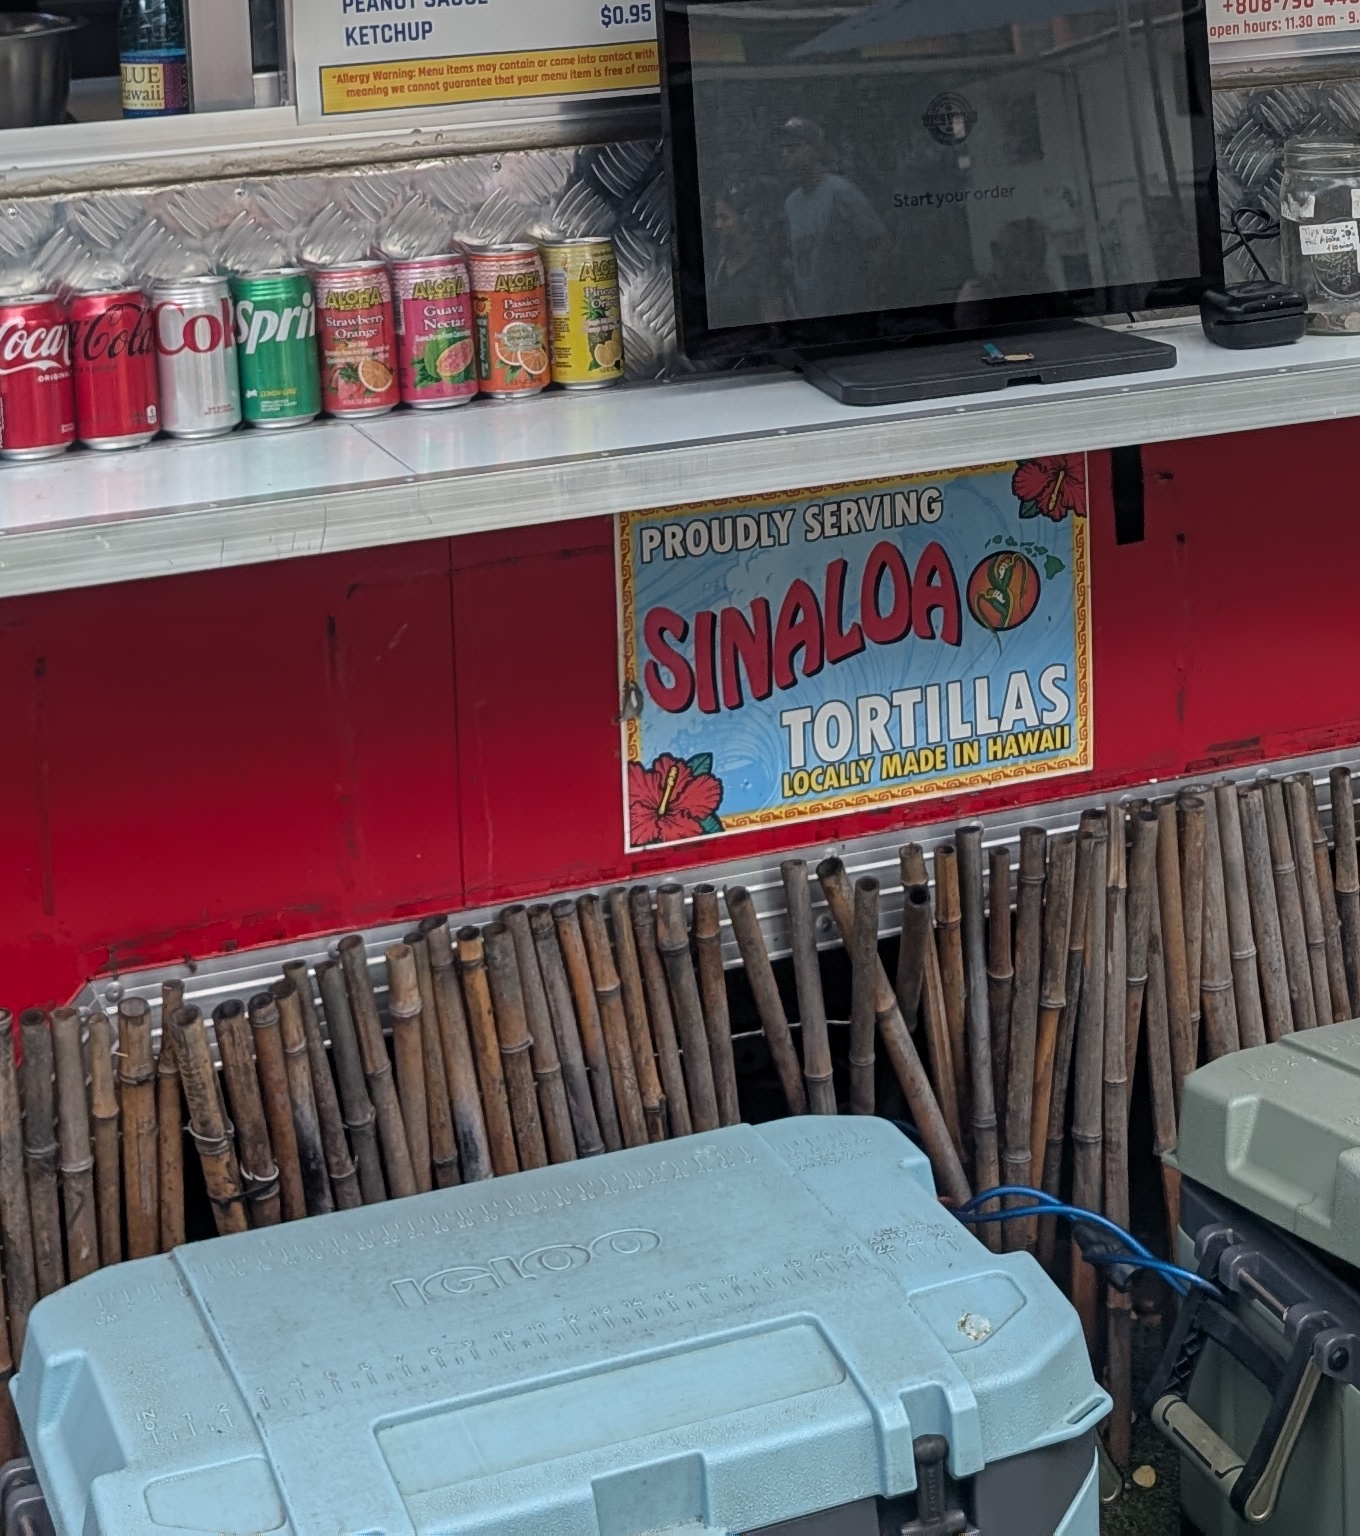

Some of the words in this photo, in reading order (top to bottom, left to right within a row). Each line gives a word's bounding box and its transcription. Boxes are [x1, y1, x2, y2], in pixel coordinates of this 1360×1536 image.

[1210, 24, 1239, 38] open
[1244, 19, 1282, 32] hours:
[1285, 15, 1313, 29] 11.30
[1318, 15, 1335, 26] am
[894, 192, 932, 207] Start
[936, 191, 970, 208] your
[974, 185, 1015, 200] order
[326, 286, 382, 310] ALOHA
[412, 275, 465, 299] ALOHA
[423, 305, 464, 316] Guava
[335, 328, 377, 339] Orange
[423, 319, 464, 329] Nectar
[640, 510, 793, 563] PROUDLY
[804, 487, 944, 542] SERVING
[643, 540, 962, 714] SINALOA
[780, 664, 1070, 769] TORTILLAS
[782, 759, 873, 798] LOCALLY
[881, 749, 947, 782] MADE
[955, 743, 980, 766] IN
[987, 726, 1070, 762] HAWAII
[392, 1228, 661, 1308] IGLOO
